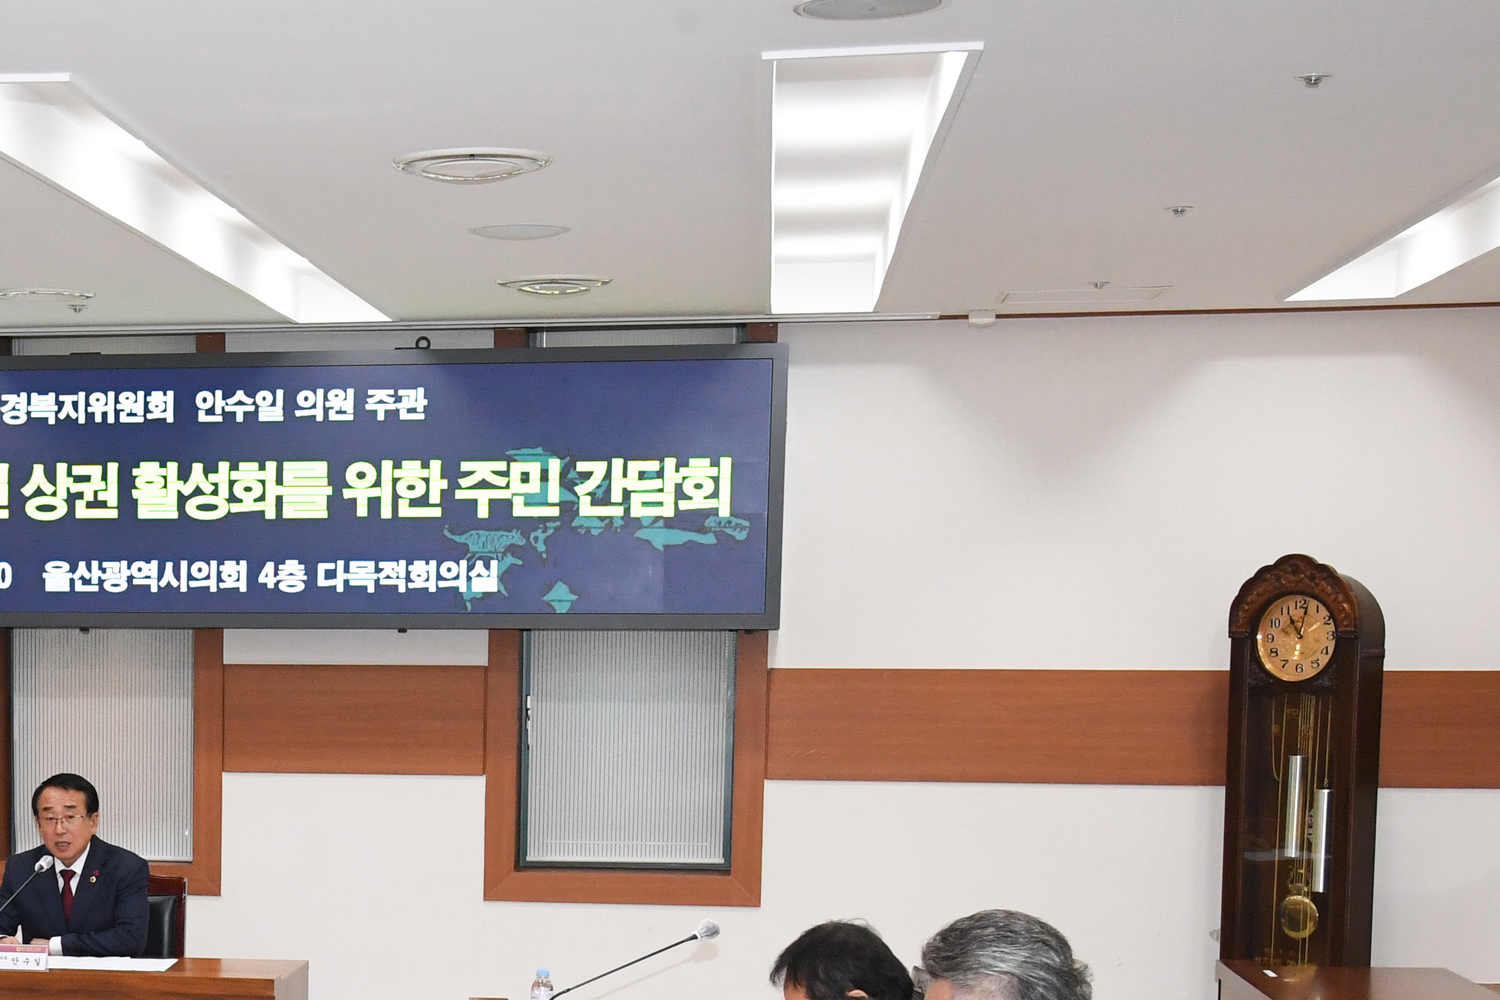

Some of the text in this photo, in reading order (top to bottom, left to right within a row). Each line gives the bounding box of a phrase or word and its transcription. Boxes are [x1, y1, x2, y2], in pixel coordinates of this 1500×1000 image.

[195, 388, 285, 423] 안수일
[294, 387, 355, 422] 의원
[364, 386, 429, 421] 주관
[20, 462, 119, 521] 상권
[131, 460, 333, 521] 활성화를
[341, 459, 448, 519] 위한
[454, 458, 561, 519] 주민
[573, 456, 733, 518] 간담회
[42, 559, 248, 593] 울산광역시의회
[257, 559, 308, 593] 4층
[317, 559, 499, 594] 다목적회의실
[1295, 599, 1307, 610] 12
[1271, 618, 1280, 628] 10
[1323, 615, 1332, 625] 2
[1267, 633, 1274, 643] 9
[1327, 631, 1335, 641] 3
[1270, 648, 1278, 657] 8
[1321, 646, 1329, 655] 4
[1281, 659, 1289, 668] 7
[1295, 663, 1304, 673] 6
[1311, 658, 1320, 668] 5
